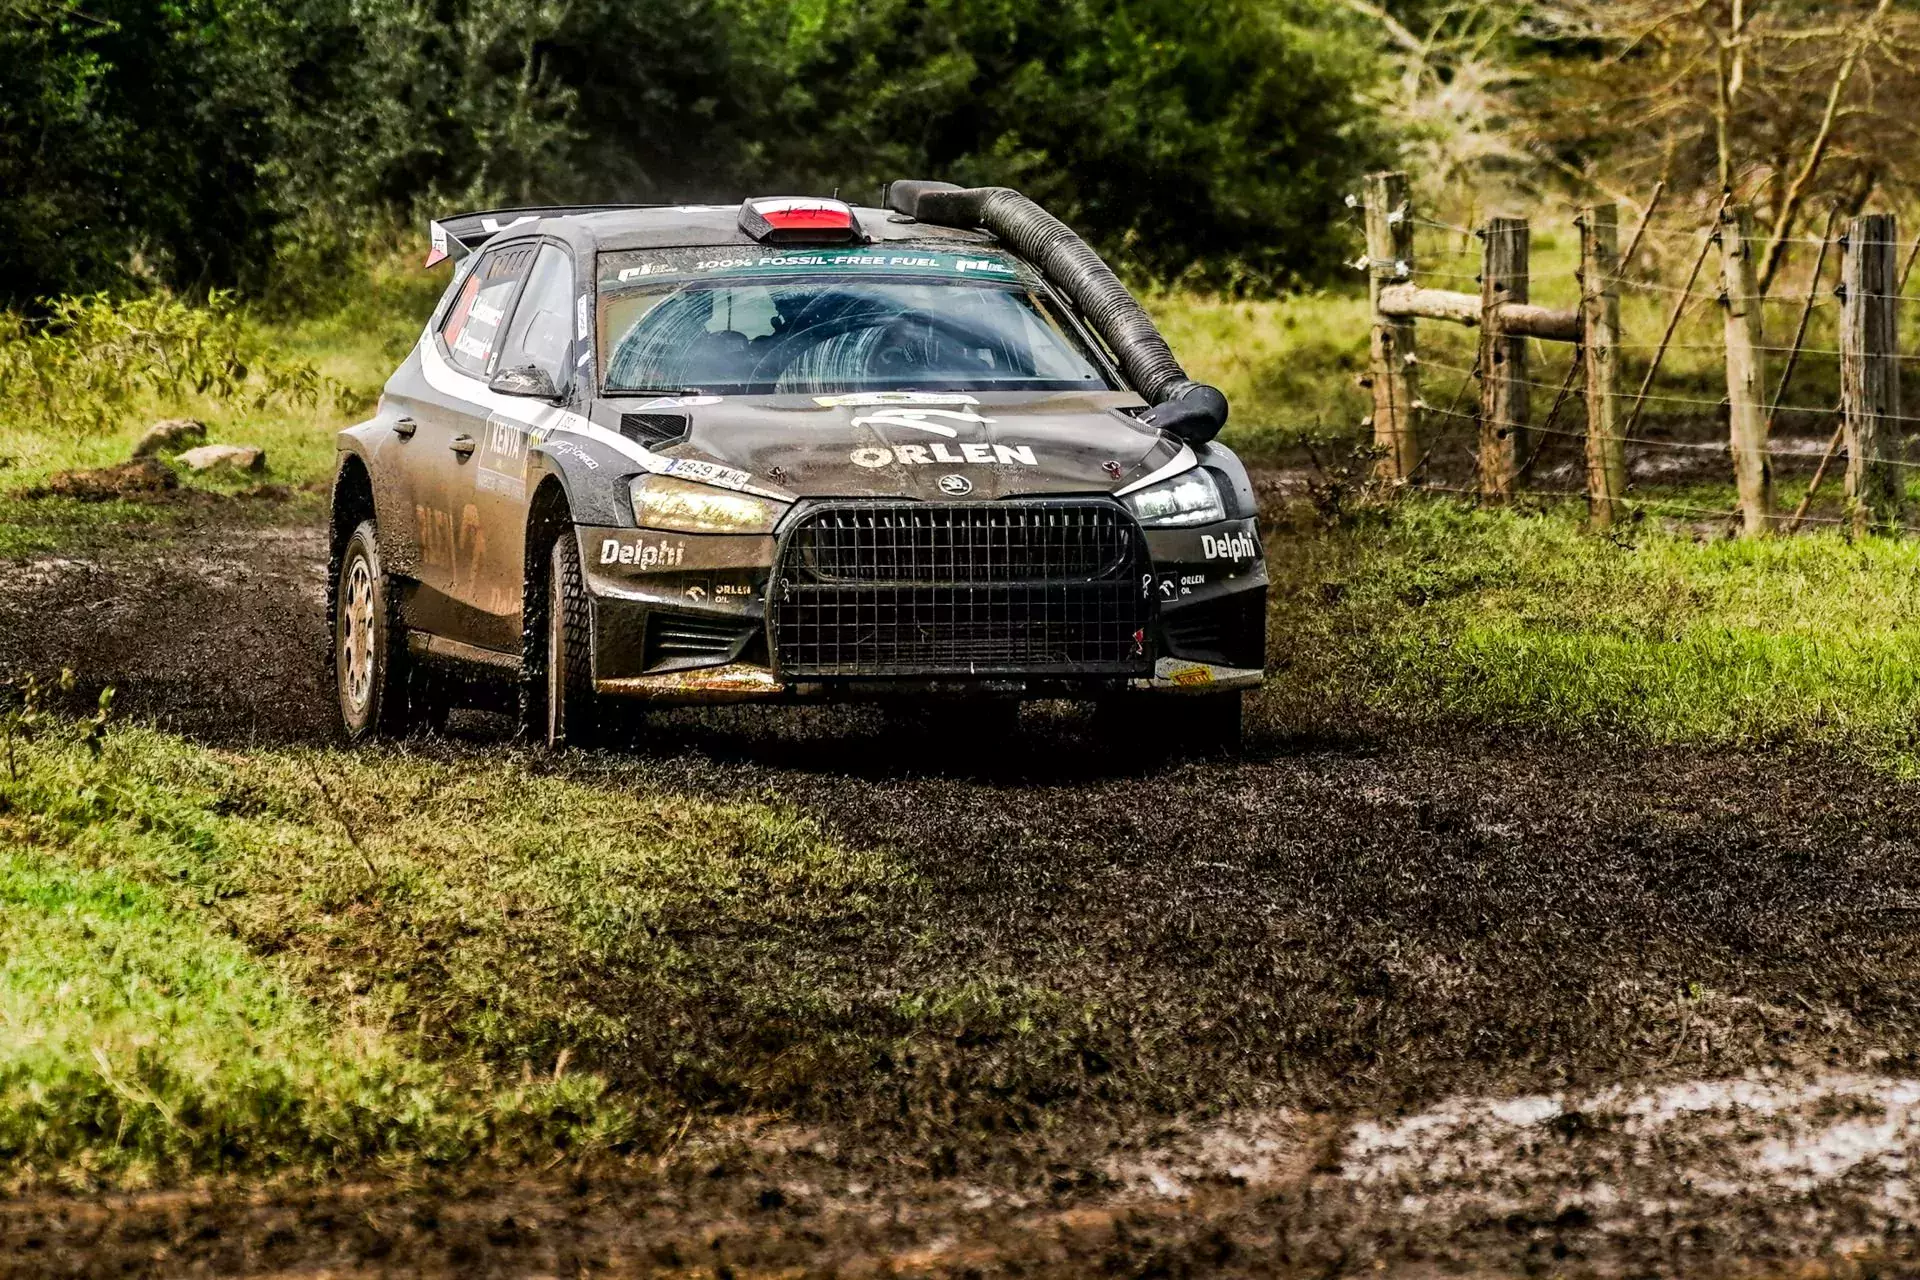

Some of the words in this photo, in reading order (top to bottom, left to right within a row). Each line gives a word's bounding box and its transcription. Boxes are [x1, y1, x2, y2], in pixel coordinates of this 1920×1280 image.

[697, 258, 752, 270] 100%
[758, 256, 886, 266] FOSSIL-FREE
[890, 257, 940, 267] FUEL
[489, 419, 521, 460] KENYA
[850, 443, 1038, 468] ORLEN
[600, 539, 686, 571] Delphi
[1201, 532, 1256, 563] Delphi
[715, 584, 751, 595] ORLEN
[1181, 575, 1205, 586] ORLEN
[1181, 587, 1192, 595] OIL
